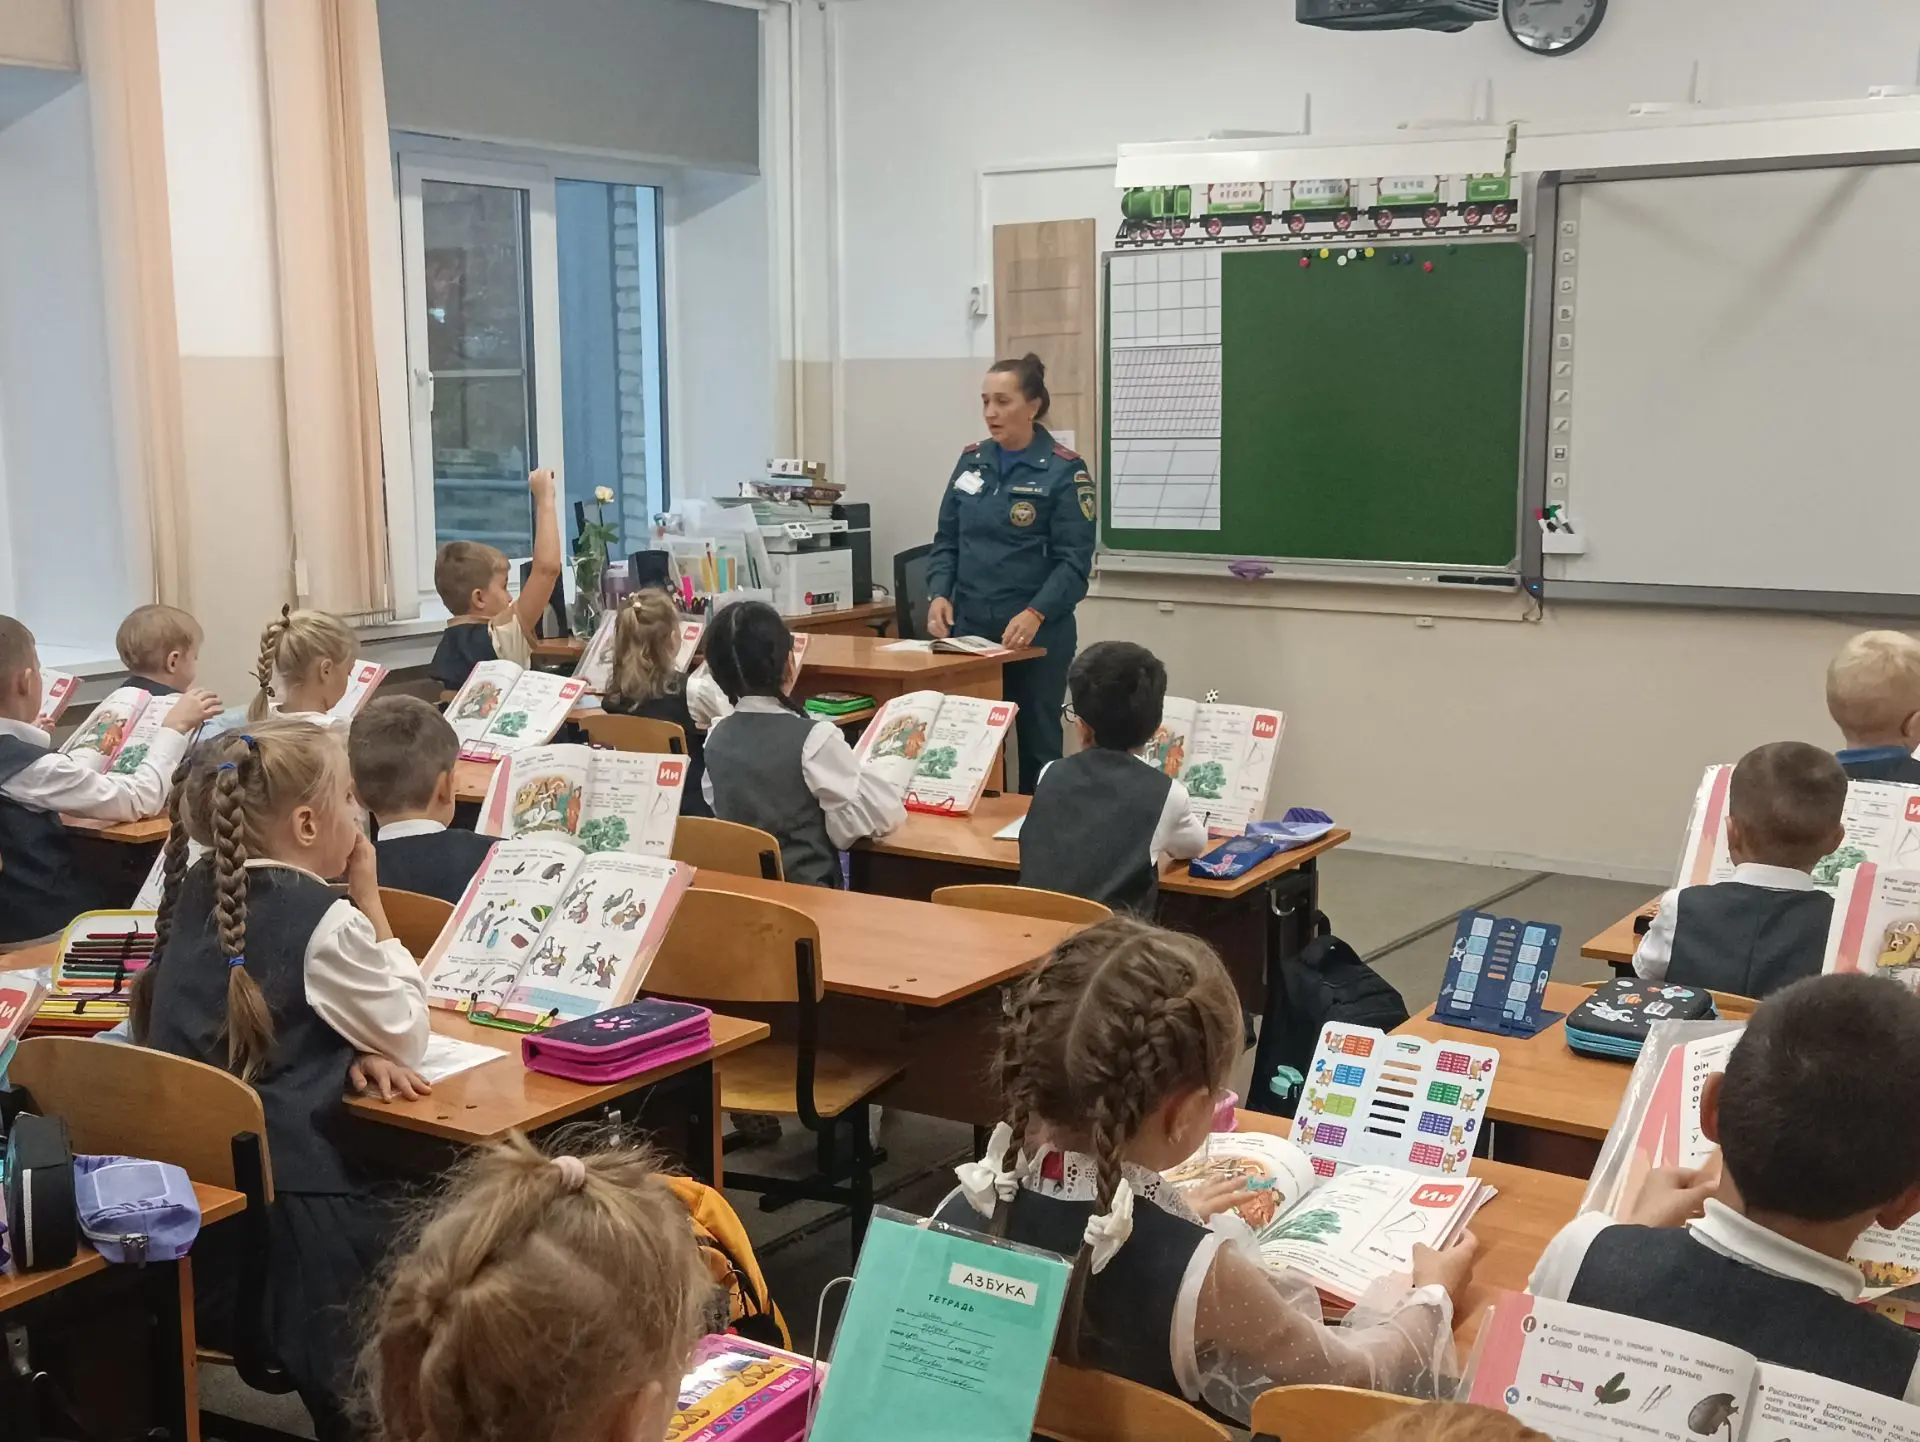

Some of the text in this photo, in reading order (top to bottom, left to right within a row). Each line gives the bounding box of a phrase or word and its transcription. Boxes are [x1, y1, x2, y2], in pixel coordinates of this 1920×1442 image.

[1518, 13, 1529, 25] 8
[1575, 13, 1586, 26] 4
[1562, 26, 1572, 39] 5
[1255, 718, 1275, 732] Ии
[659, 768, 680, 781] Ии
[1324, 1031, 1332, 1044] 1
[1316, 1059, 1326, 1072] 2
[1481, 1059, 1493, 1072] 6
[1475, 1088, 1485, 1101] 7
[1298, 1116, 1308, 1130] 4
[1464, 1118, 1476, 1132] 8
[1457, 1149, 1468, 1162] 9
[1418, 1188, 1456, 1203] Ии
[962, 1272, 1026, 1300] АЗБУКА
[928, 1293, 975, 1313] ТЕТРАДЬ
[1547, 1335, 1573, 1350] Слово
[1616, 1352, 1658, 1369] значения
[1768, 1386, 1820, 1406] Рассмотрите
[1871, 1415, 1887, 1427] Кто
[1893, 1423, 1904, 1432] на
[1813, 1417, 1846, 1432] каждую
[1822, 1408, 1882, 1435] Восстановите
